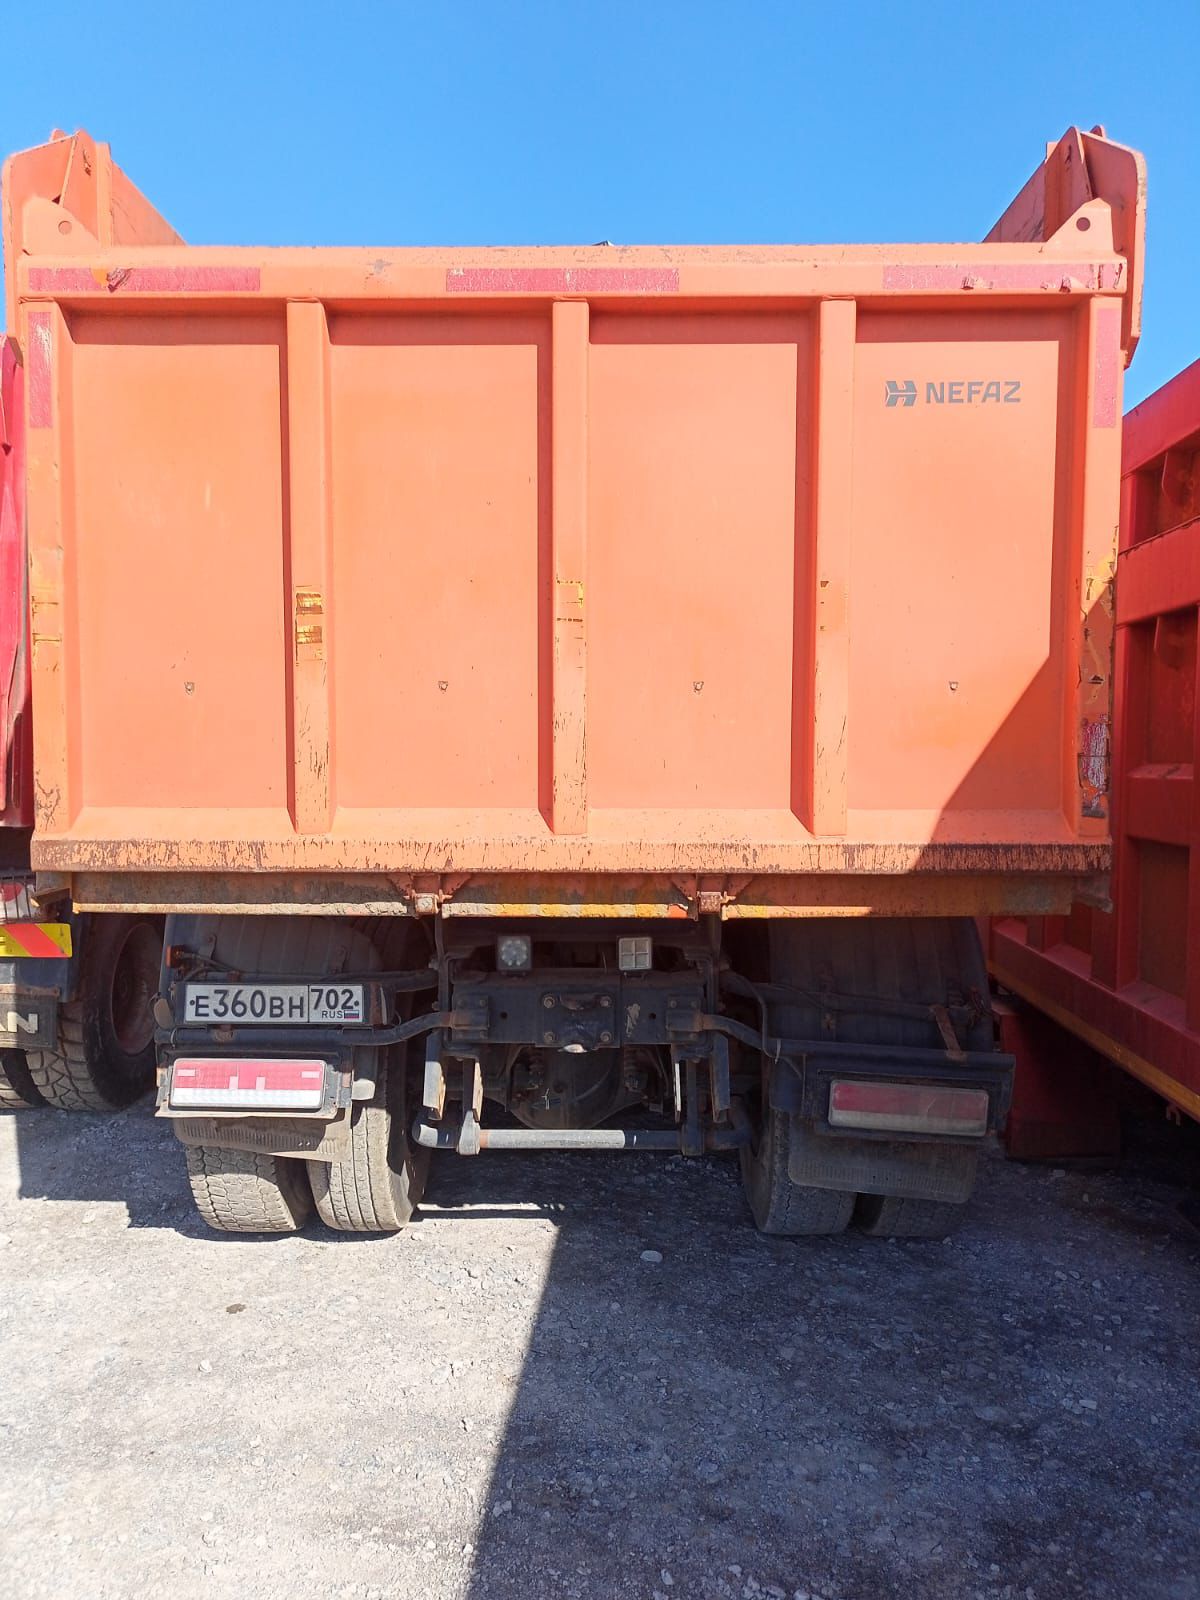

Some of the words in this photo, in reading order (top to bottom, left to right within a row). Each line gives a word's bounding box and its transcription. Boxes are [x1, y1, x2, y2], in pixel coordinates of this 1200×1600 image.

[926, 381, 1021, 404] NEFAZ
[311, 988, 354, 1010] 702
[321, 1010, 343, 1019] RUS
